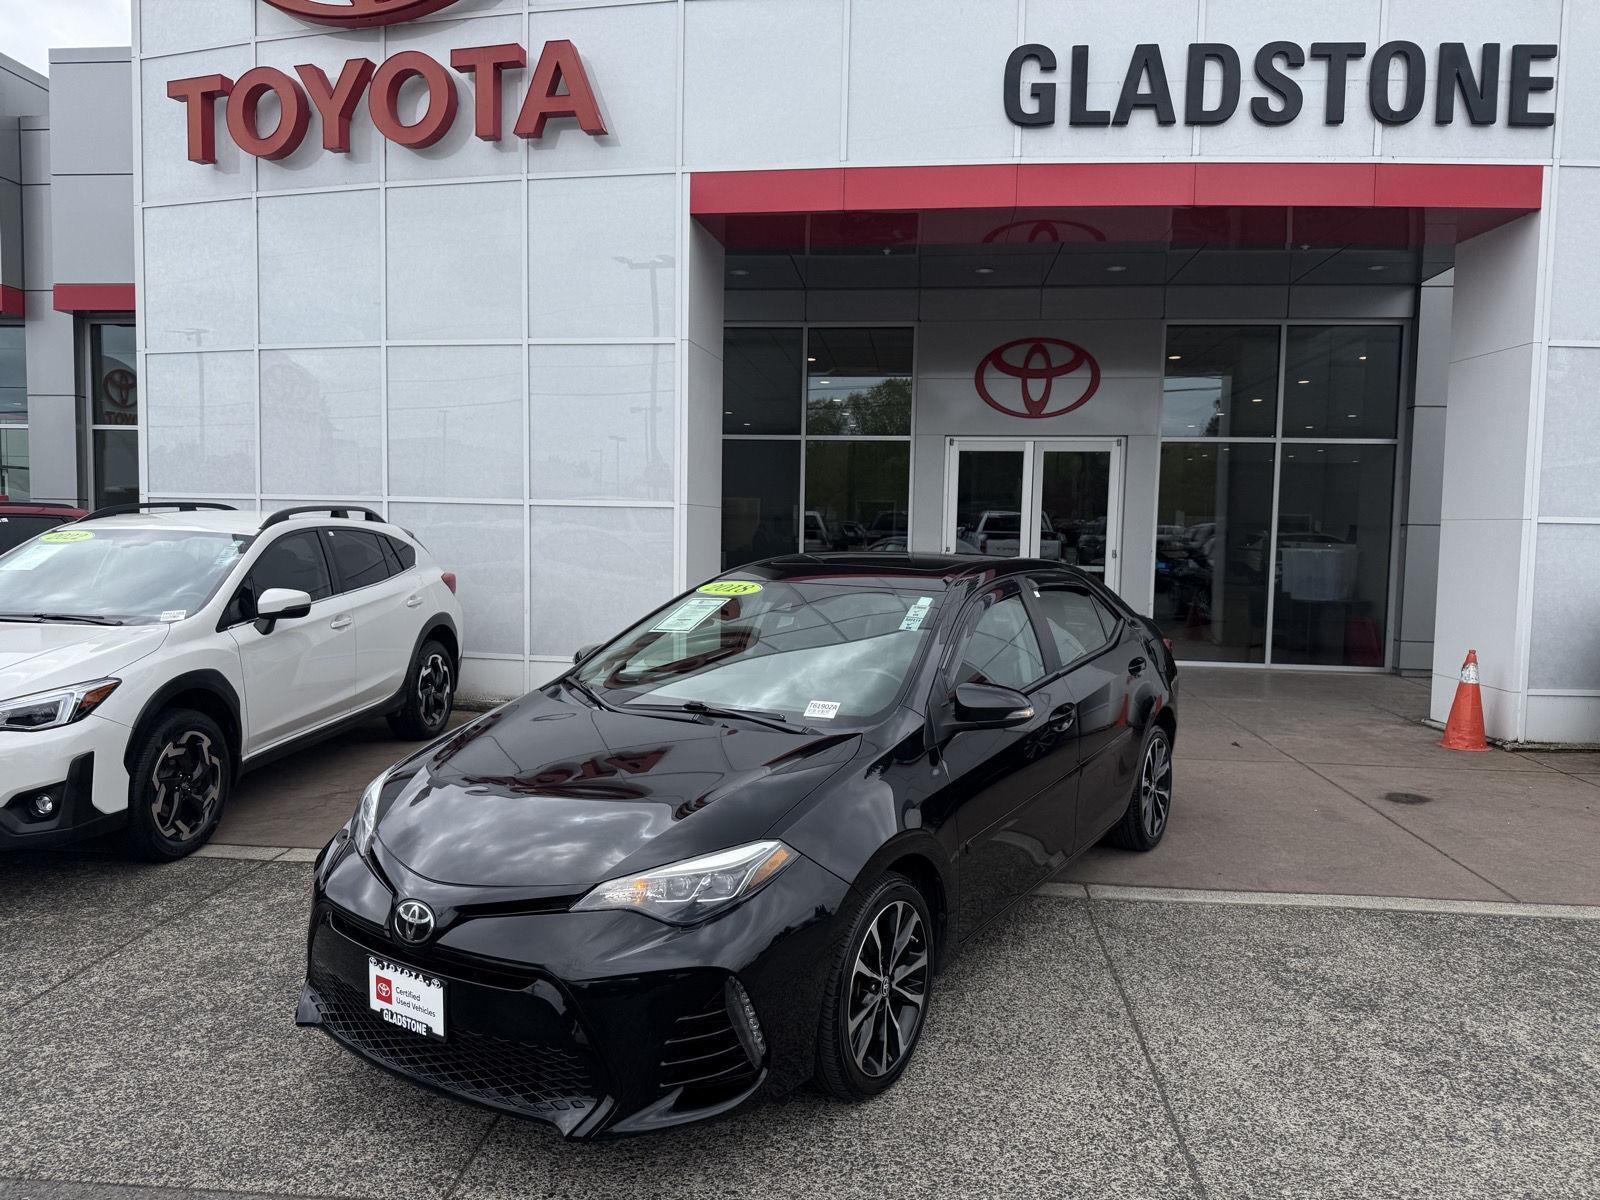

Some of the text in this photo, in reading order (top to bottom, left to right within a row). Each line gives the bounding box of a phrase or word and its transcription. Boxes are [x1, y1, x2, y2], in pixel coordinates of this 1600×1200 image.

[1003, 40, 1558, 128] GLADSTONE
[166, 39, 608, 165] TOYOTA
[704, 583, 756, 594] 2018
[382, 961, 424, 982] TOYOTA
[395, 986, 421, 1002] Certified
[396, 997, 436, 1018] Used Vehicles
[383, 1009, 427, 1036] GLADSTONE
